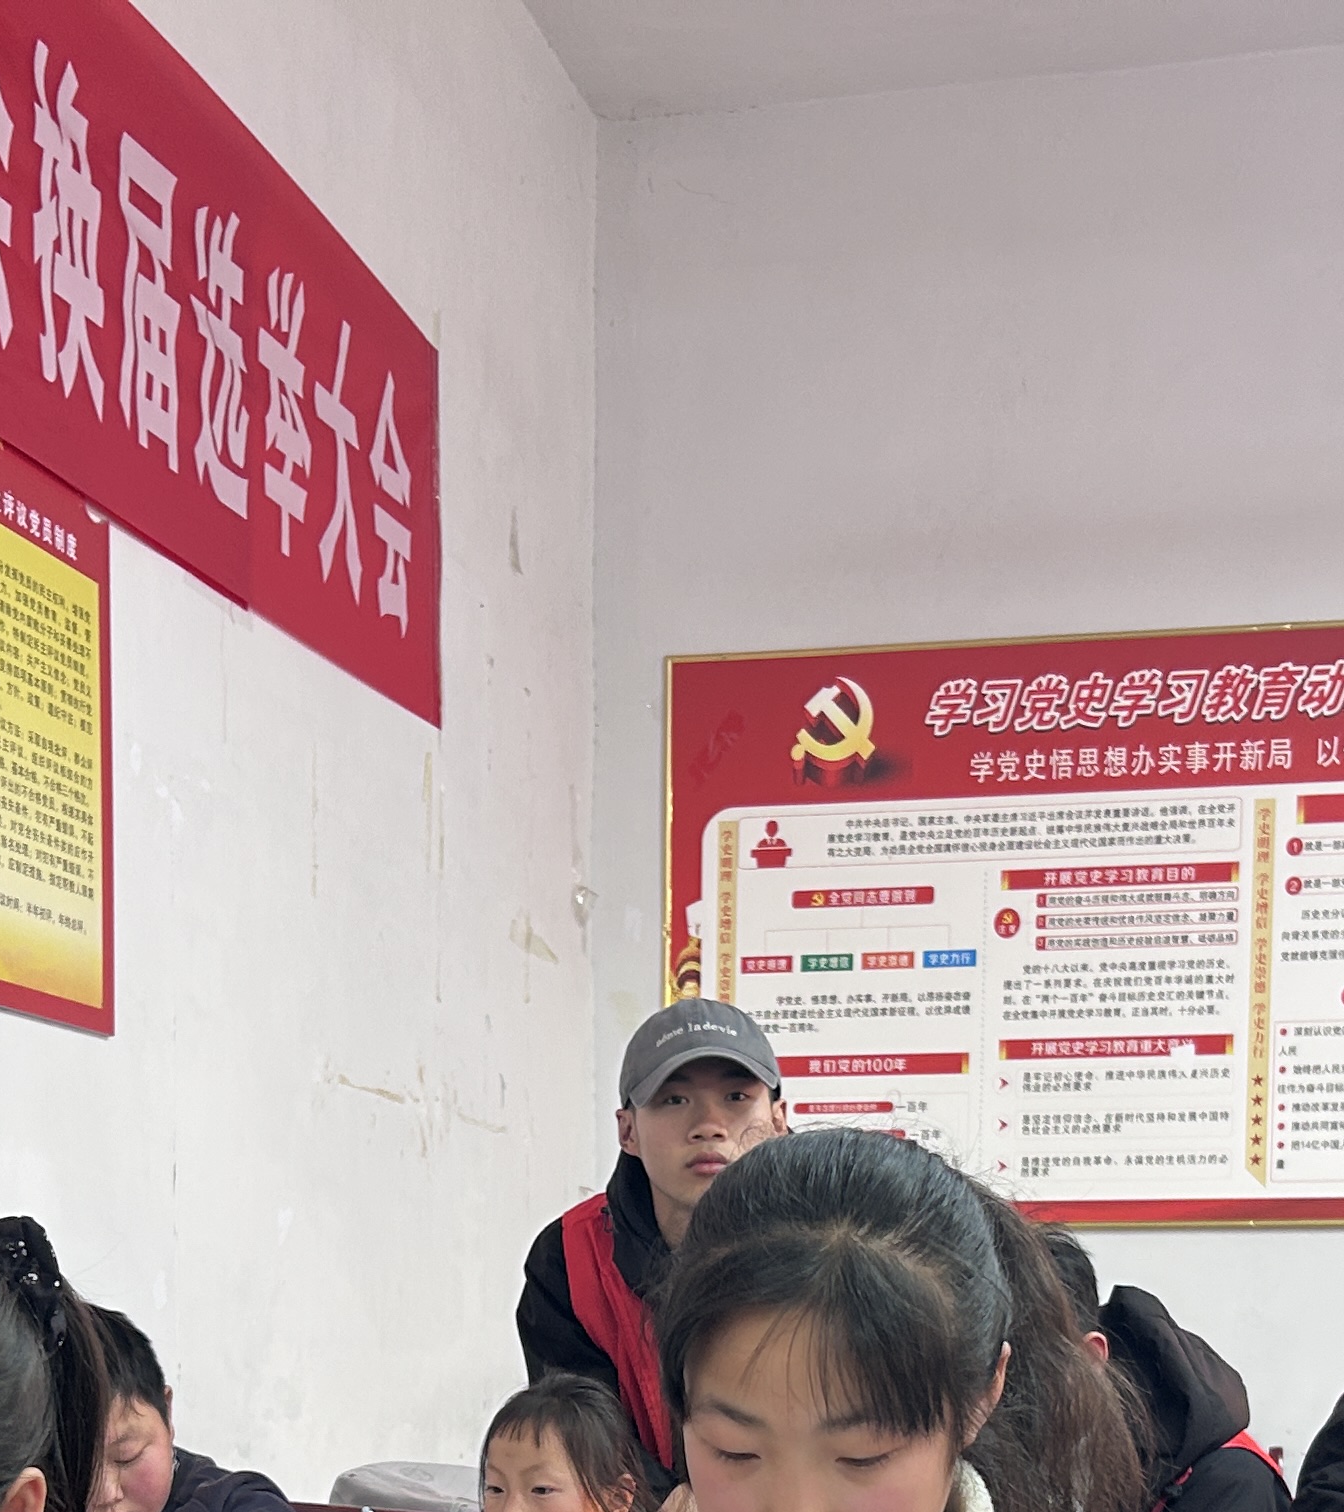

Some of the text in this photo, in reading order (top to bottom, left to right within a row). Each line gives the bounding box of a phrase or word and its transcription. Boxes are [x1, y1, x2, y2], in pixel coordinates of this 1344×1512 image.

[969, 739, 1293, 783] 学党史悟思想办实事开新局
[1043, 866, 1197, 886] 开展党史学习教育目的
[927, 951, 972, 965] 学史力行
[808, 1059, 907, 1074] 我们党的100年
